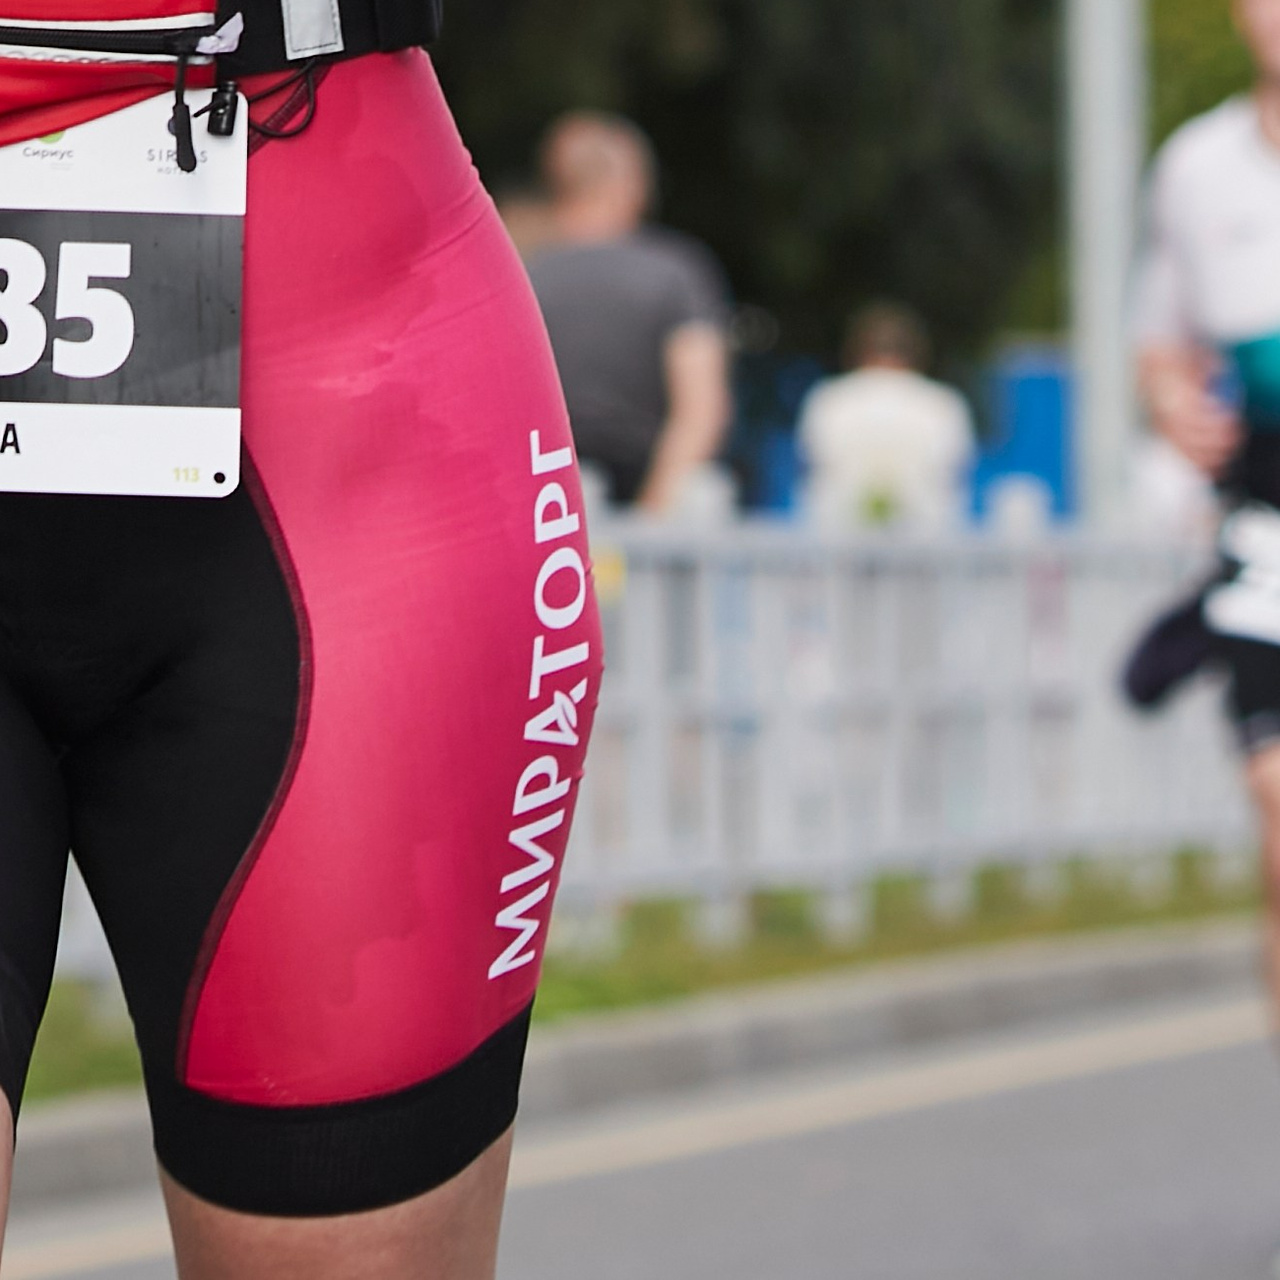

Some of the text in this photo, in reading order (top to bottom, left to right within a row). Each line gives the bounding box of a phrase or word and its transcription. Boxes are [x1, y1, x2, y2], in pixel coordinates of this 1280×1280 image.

[22, 146, 75, 161] Сириус
[146, 148, 208, 163] SIRS
[173, 466, 200, 483] 113
[487, 428, 590, 981] МИРАТОРГ
